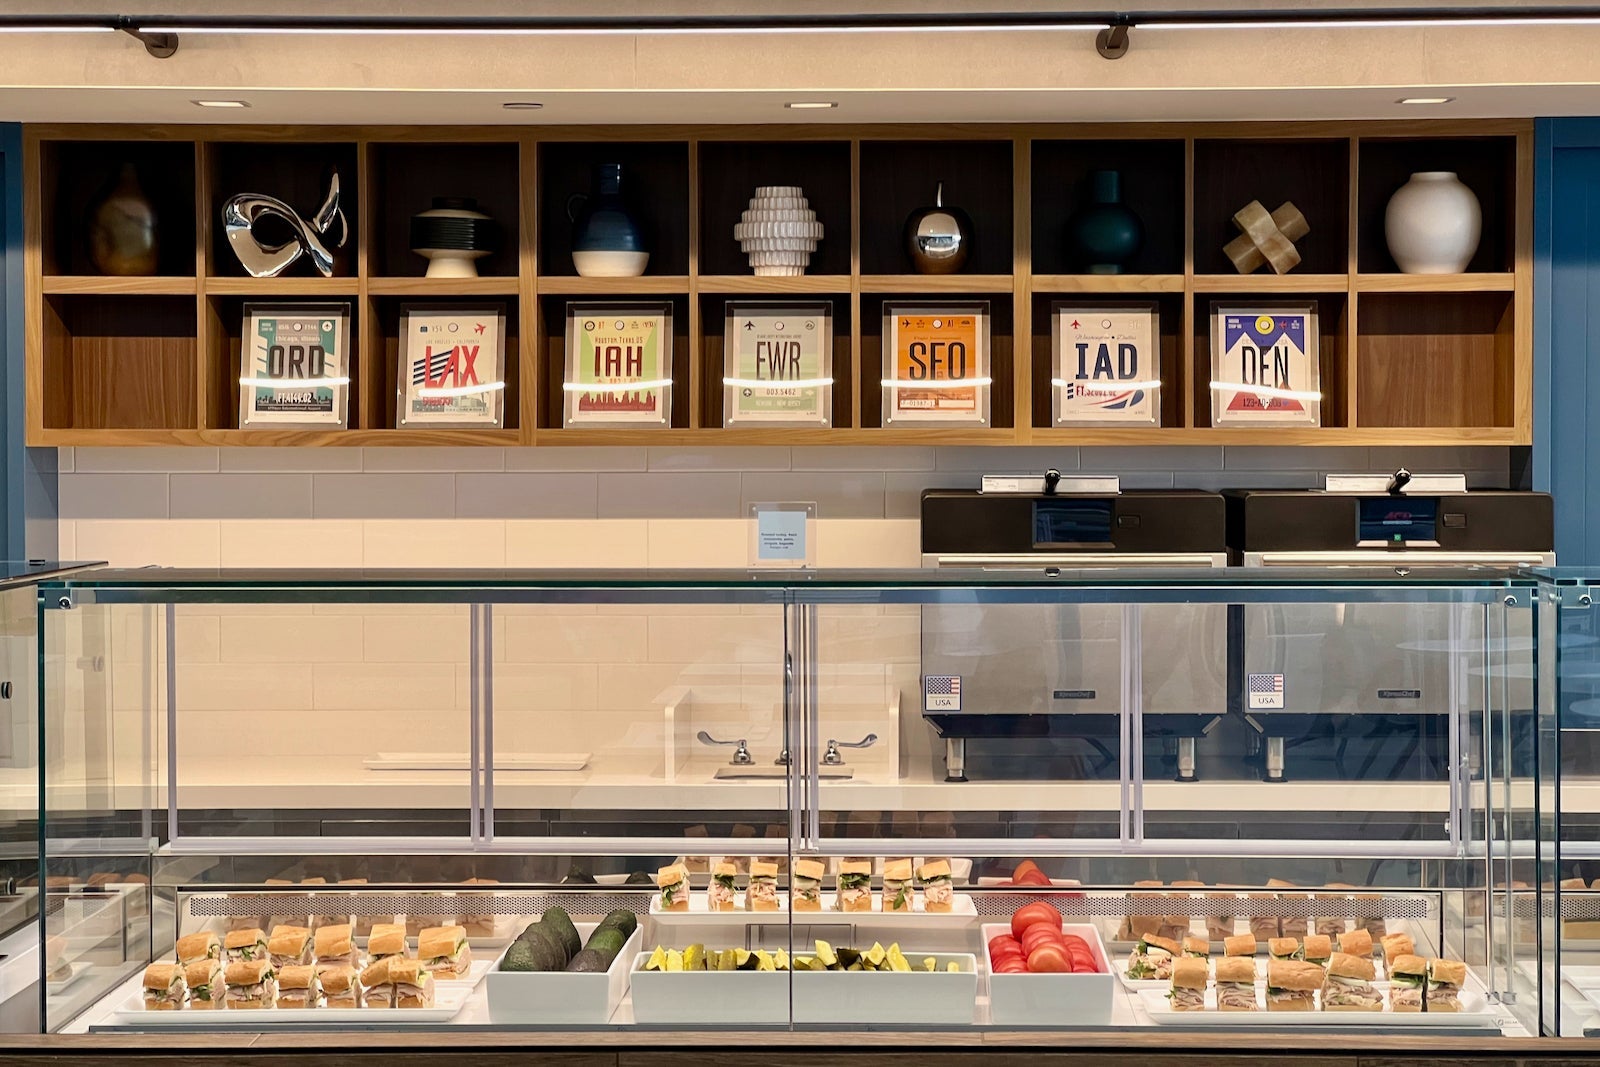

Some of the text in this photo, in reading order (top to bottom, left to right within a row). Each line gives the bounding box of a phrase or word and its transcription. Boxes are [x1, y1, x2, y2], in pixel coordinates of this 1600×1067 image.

[268, 345, 325, 379] ORD
[424, 345, 480, 389] LAX
[594, 346, 643, 377] IAH
[756, 341, 801, 381] EWR
[909, 341, 966, 381] SFO
[1075, 343, 1138, 380] IAD
[1241, 346, 1289, 390] DEN
[934, 698, 952, 707] USA
[1258, 697, 1275, 705] USA
